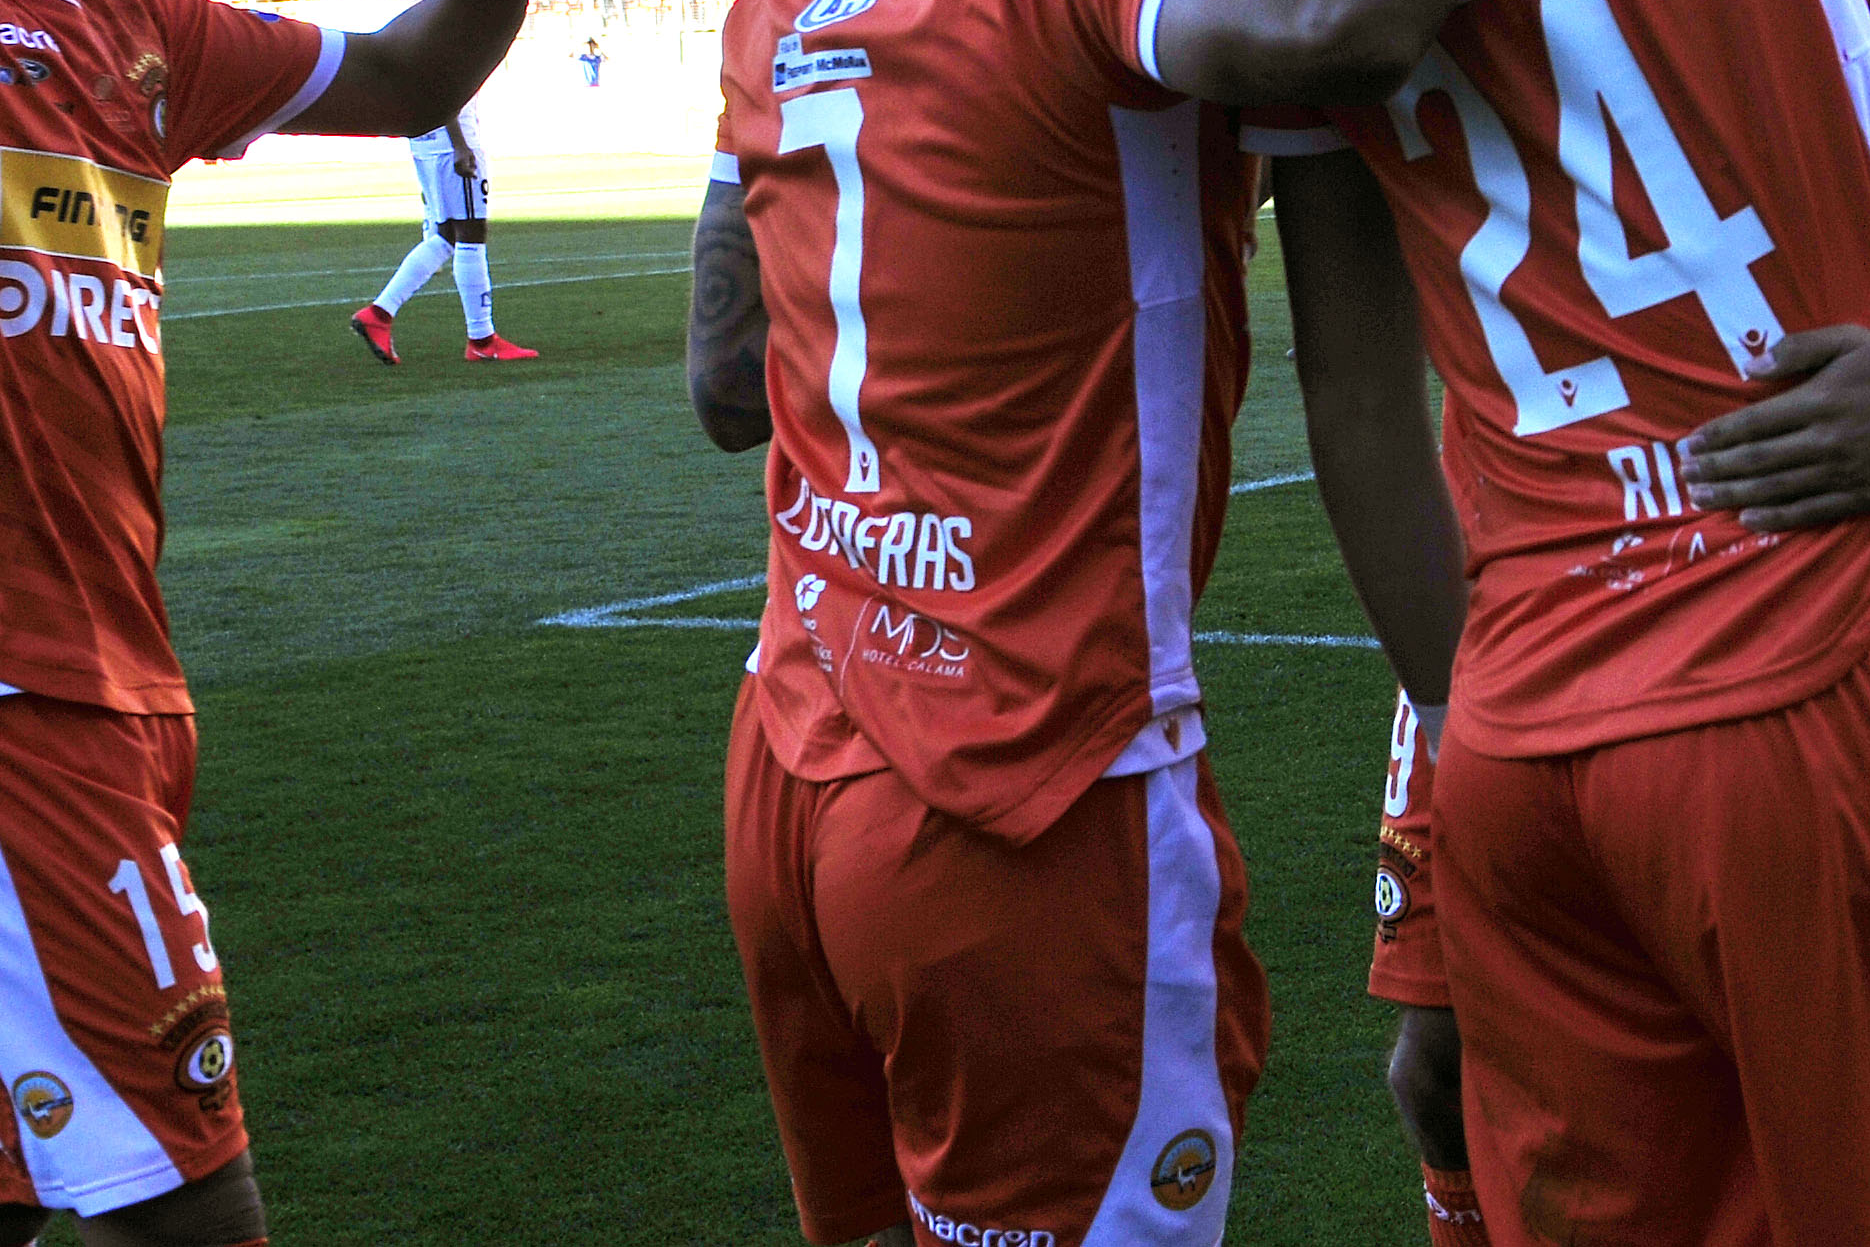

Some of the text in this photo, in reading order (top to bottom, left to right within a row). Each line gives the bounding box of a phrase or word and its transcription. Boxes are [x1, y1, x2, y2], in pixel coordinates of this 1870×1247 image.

[0, 260, 162, 354] DIREC
[778, 87, 881, 493] 7
[1607, 440, 1701, 521] RI
[907, 660, 965, 678] CALAMA
[107, 841, 218, 990] 15
